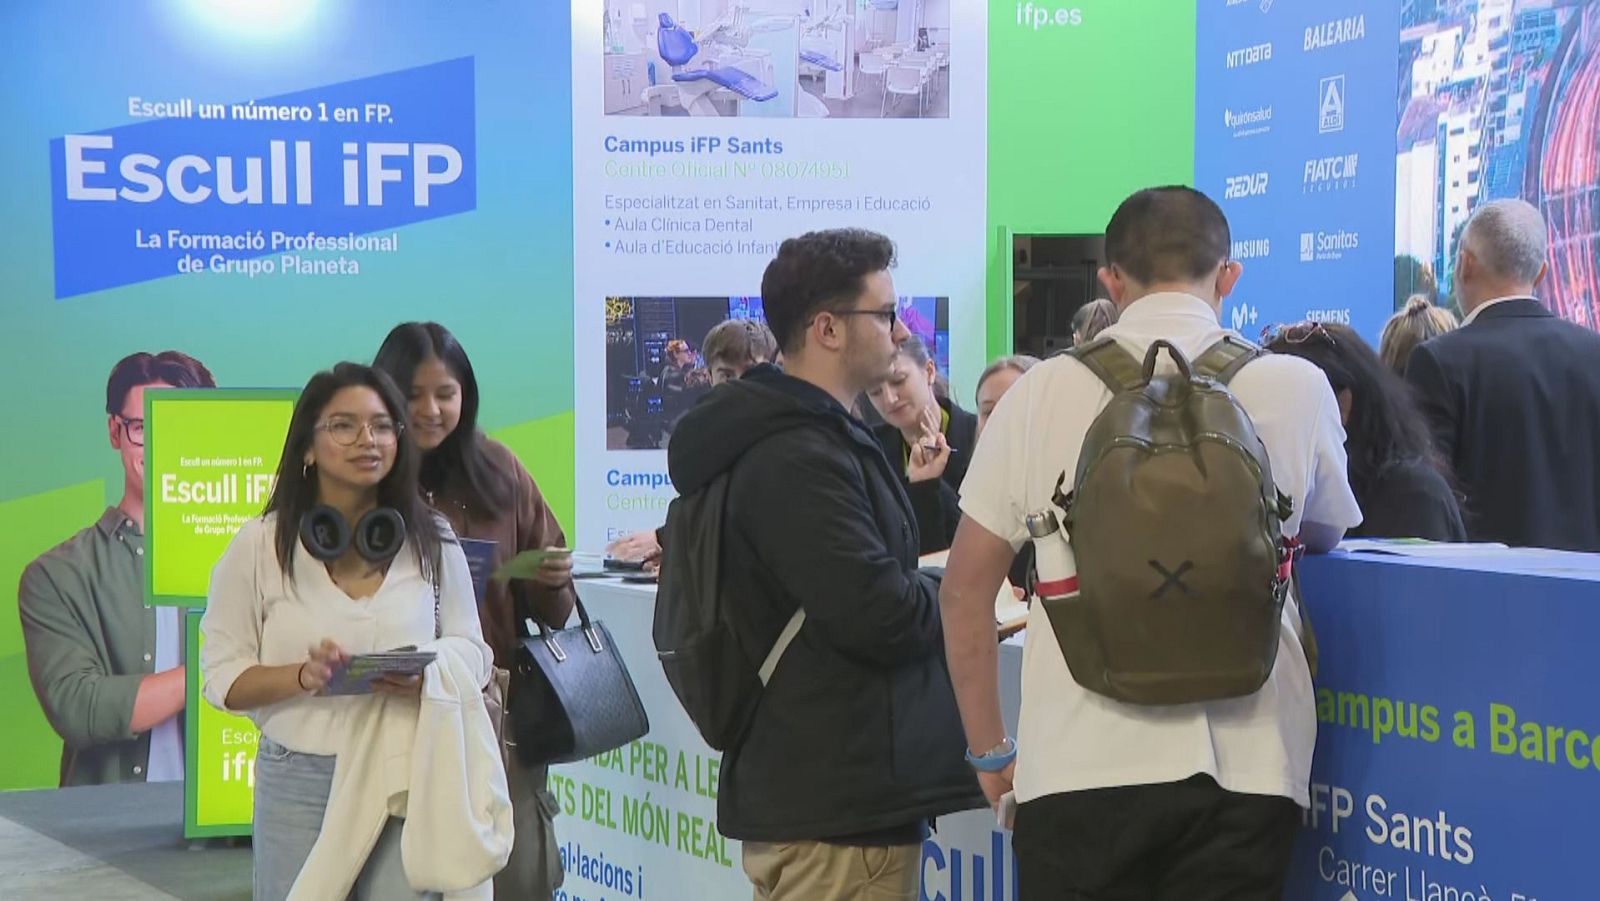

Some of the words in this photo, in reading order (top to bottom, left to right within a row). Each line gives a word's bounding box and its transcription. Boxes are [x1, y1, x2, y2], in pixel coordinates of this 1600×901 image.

[1016, 0, 1082, 31] ifp.es
[128, 97, 191, 118] Escull
[199, 103, 225, 119] un
[231, 100, 312, 121] número
[318, 103, 329, 121] 1
[334, 108, 358, 122] en
[365, 105, 394, 124] FP.
[604, 136, 685, 156] Campus
[691, 137, 721, 153] iFP
[727, 137, 783, 154] Sants
[64, 135, 312, 204] Escull
[343, 142, 463, 207] iFP
[604, 160, 666, 178] Centre
[671, 160, 728, 178] Oficial
[761, 161, 850, 179] 08074951
[1304, 156, 1343, 183] FIATC
[1225, 172, 1269, 200] REDUR
[604, 195, 698, 212] Especialitzat
[703, 200, 722, 210] en
[726, 196, 782, 212] Sanitat,
[787, 197, 852, 213] Empresa
[857, 197, 860, 209] i
[864, 197, 930, 212] Educació
[614, 217, 647, 232] Aula
[651, 217, 701, 232] Clínica
[705, 217, 753, 232] Dental
[135, 229, 161, 248] La
[167, 230, 265, 251] Formació
[271, 232, 398, 252] Professional
[615, 240, 647, 254] Aula
[737, 240, 780, 255] Infant
[1231, 238, 1270, 259] MSUNG
[1317, 229, 1359, 251] Sanitas
[177, 255, 203, 273] de
[209, 255, 274, 278] Grupo
[281, 257, 359, 275] Planeta
[161, 473, 237, 504] Escull
[607, 469, 673, 489] Campu
[607, 494, 668, 511] Centre
[1317, 687, 1440, 744] ampus
[1453, 708, 1475, 749] a
[222, 728, 258, 745] Esc
[630, 740, 668, 785] PER
[675, 751, 688, 792] A
[695, 755, 719, 799] LE
[547, 772, 576, 816] TS
[582, 782, 617, 830] DEL
[623, 791, 669, 848] MÓN
[677, 812, 732, 868] REAL
[1365, 794, 1474, 864] Sants
[560, 841, 633, 895] al·lacions
[637, 865, 643, 900] i
[1319, 846, 1397, 897] Carrer
